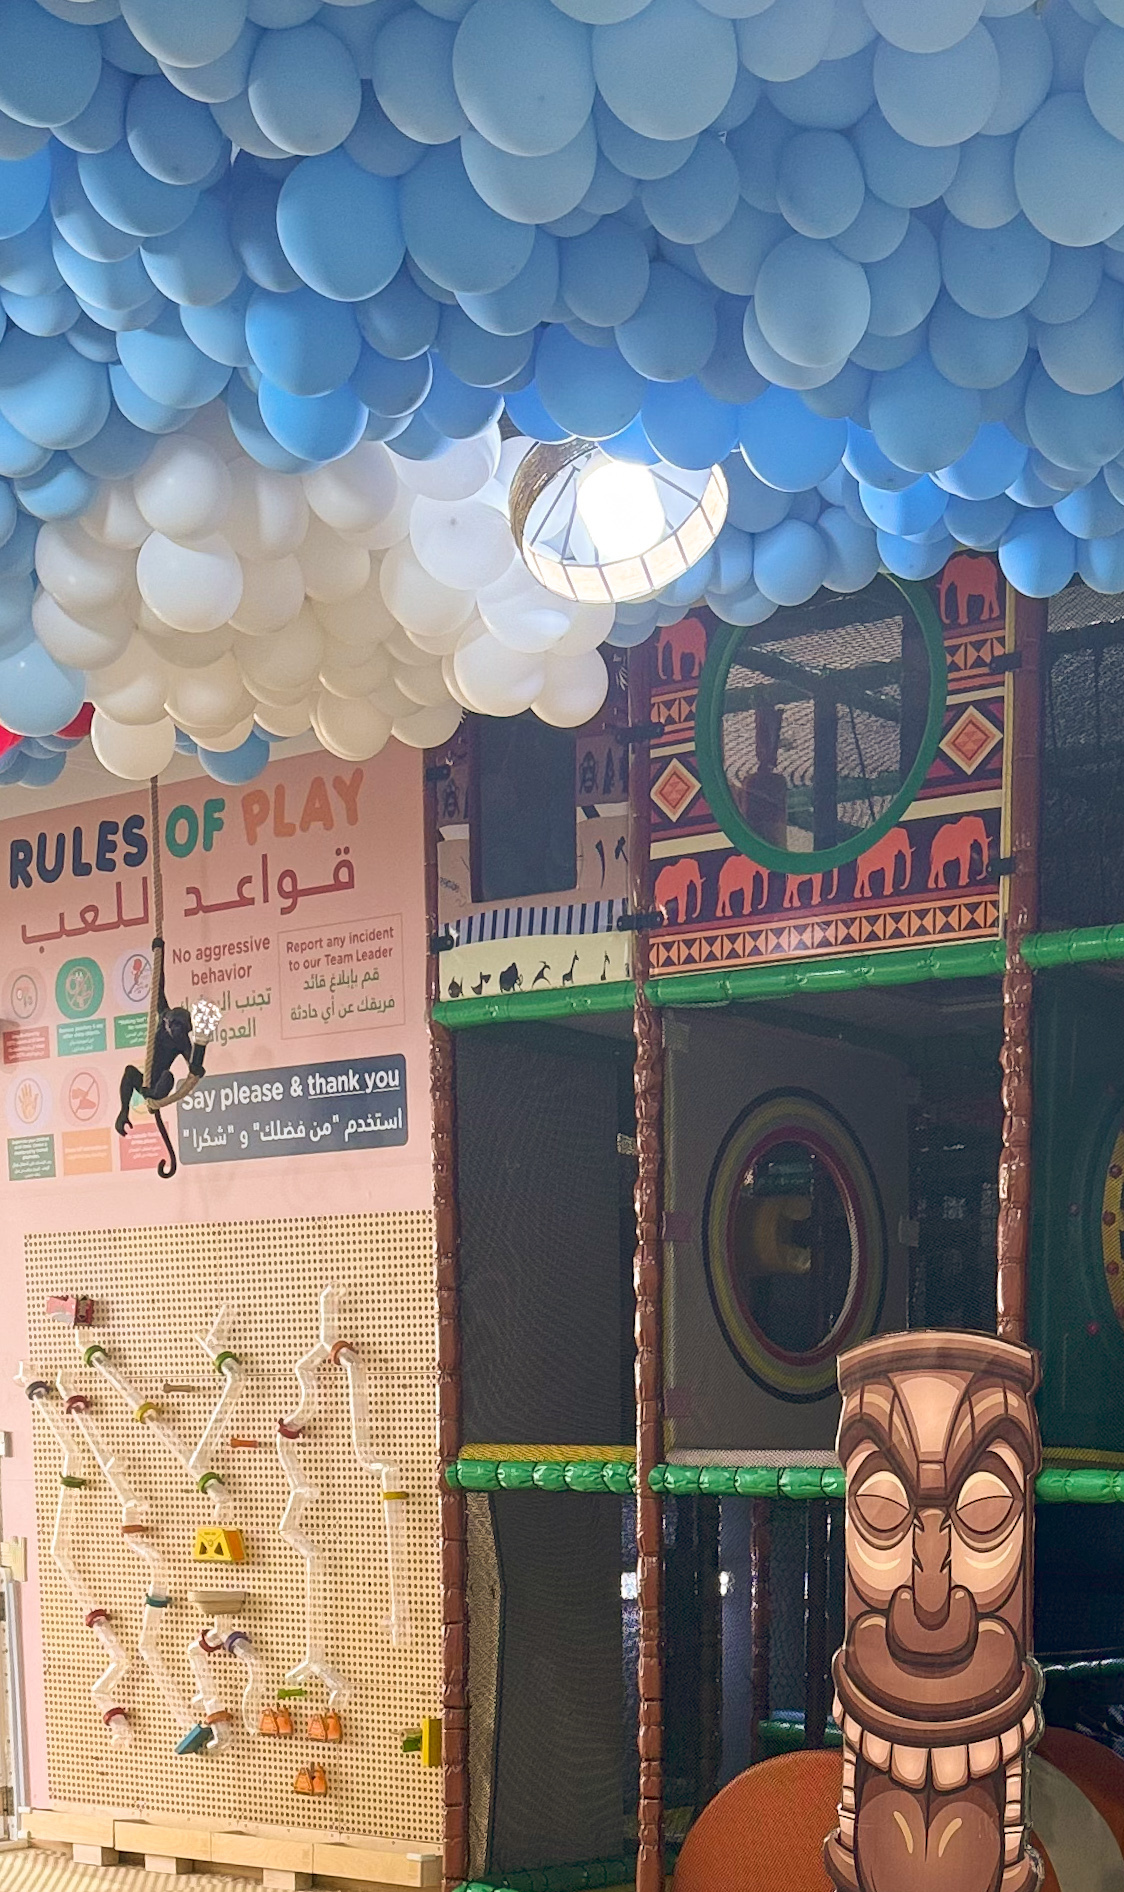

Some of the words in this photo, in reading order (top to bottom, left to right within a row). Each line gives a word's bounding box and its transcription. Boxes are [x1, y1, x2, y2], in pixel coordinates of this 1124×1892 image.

[10, 815, 148, 889] RULES
[165, 798, 226, 858] OF
[241, 768, 364, 846] PLAY
[184, 846, 355, 917] قواعد
[21, 876, 149, 954] للعب
[172, 948, 191, 964] No
[196, 935, 270, 962] aggressive
[286, 937, 323, 954] Report
[327, 934, 346, 949] any
[349, 927, 394, 943] incident
[289, 960, 300, 972] to
[303, 957, 321, 971] our
[324, 953, 353, 967] Team
[356, 946, 393, 962] Leader
[191, 964, 252, 986] behavior
[303, 973, 326, 991] قائد
[361, 968, 380, 989] قم
[235, 987, 272, 1013] تجنب
[321, 995, 335, 1023] أي
[338, 1001, 354, 1018] عن
[181, 1087, 216, 1112] Say
[220, 1081, 284, 1111] please
[290, 1076, 303, 1097] &
[307, 1069, 360, 1096] thank
[365, 1068, 400, 1094] you
[344, 1107, 403, 1142] استخدم
